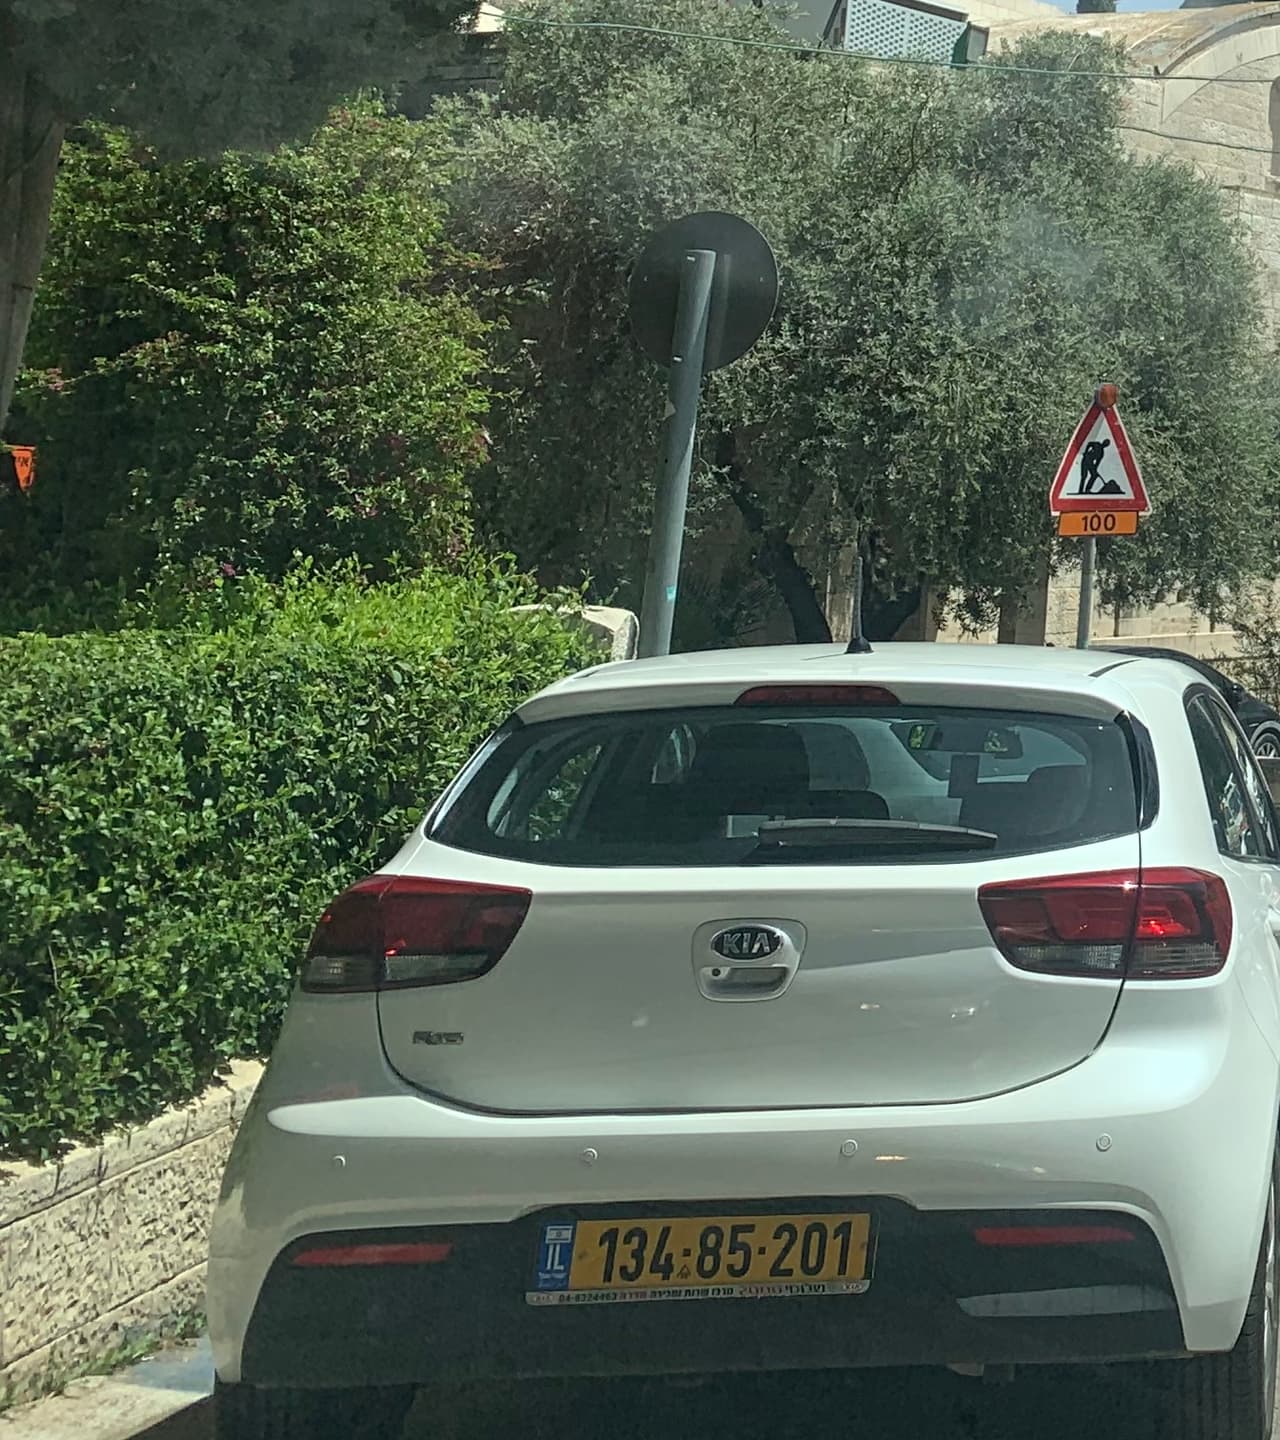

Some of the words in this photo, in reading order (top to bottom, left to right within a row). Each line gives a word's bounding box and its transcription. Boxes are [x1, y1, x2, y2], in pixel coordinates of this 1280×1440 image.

[1081, 513, 1116, 531] 100
[723, 932, 771, 954] KIA
[546, 1244, 564, 1270] IL
